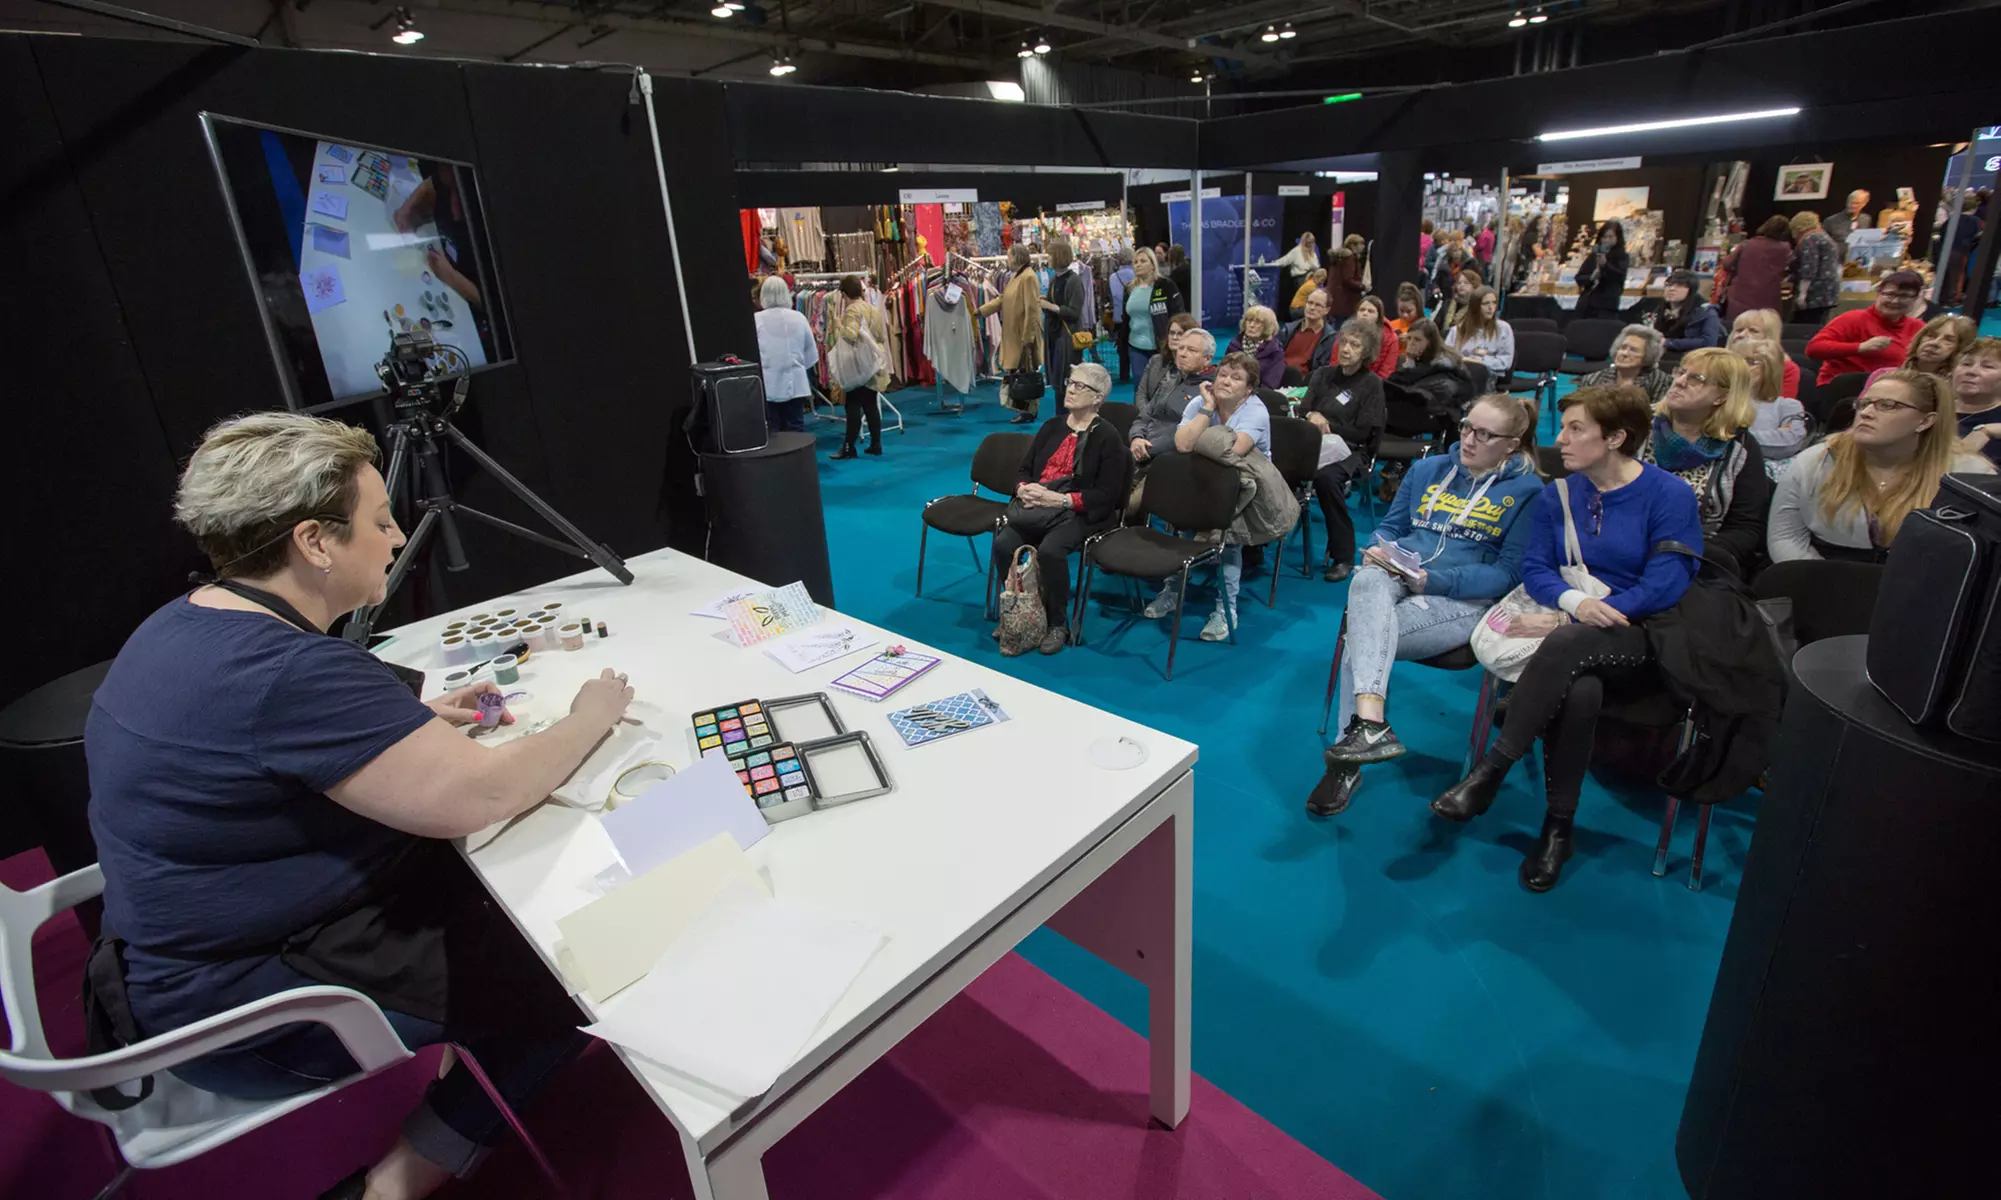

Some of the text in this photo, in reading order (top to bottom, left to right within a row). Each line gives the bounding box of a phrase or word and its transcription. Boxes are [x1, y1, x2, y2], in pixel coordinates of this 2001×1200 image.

[1211, 219, 1247, 228] BRADLE
[1252, 219, 1261, 227] &
[1262, 218, 1276, 227] CO
